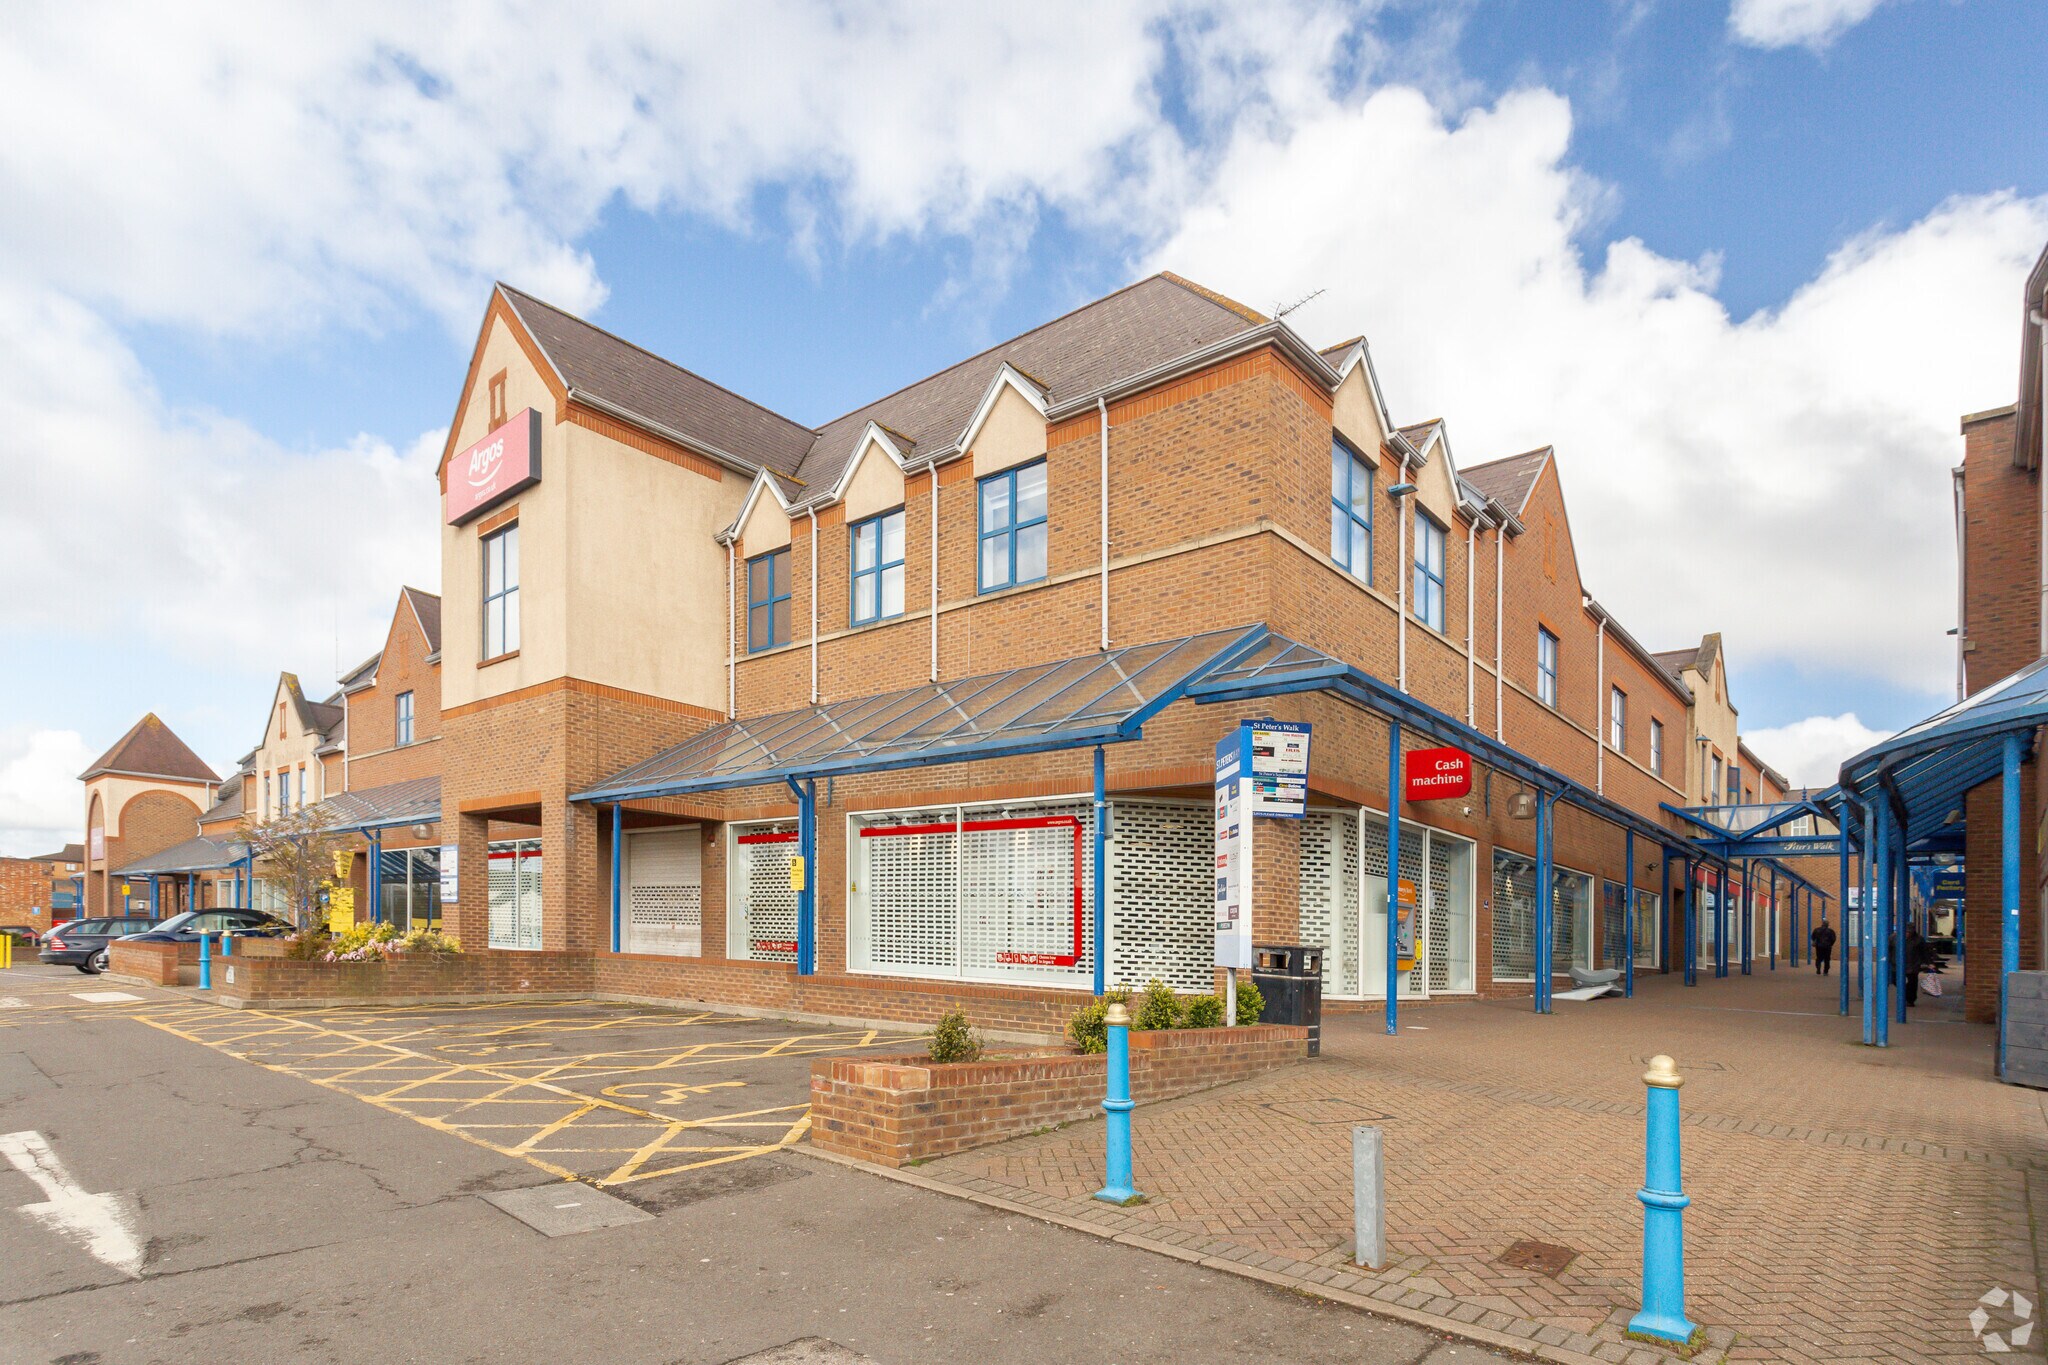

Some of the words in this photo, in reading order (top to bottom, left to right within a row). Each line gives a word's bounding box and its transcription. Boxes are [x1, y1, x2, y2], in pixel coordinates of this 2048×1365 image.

[468, 438, 504, 477] Argos
[1435, 758, 1464, 771] Cash
[1412, 773, 1464, 786] machine
[1784, 841, 1811, 851] Peter's
[1813, 841, 1835, 851] Walk
